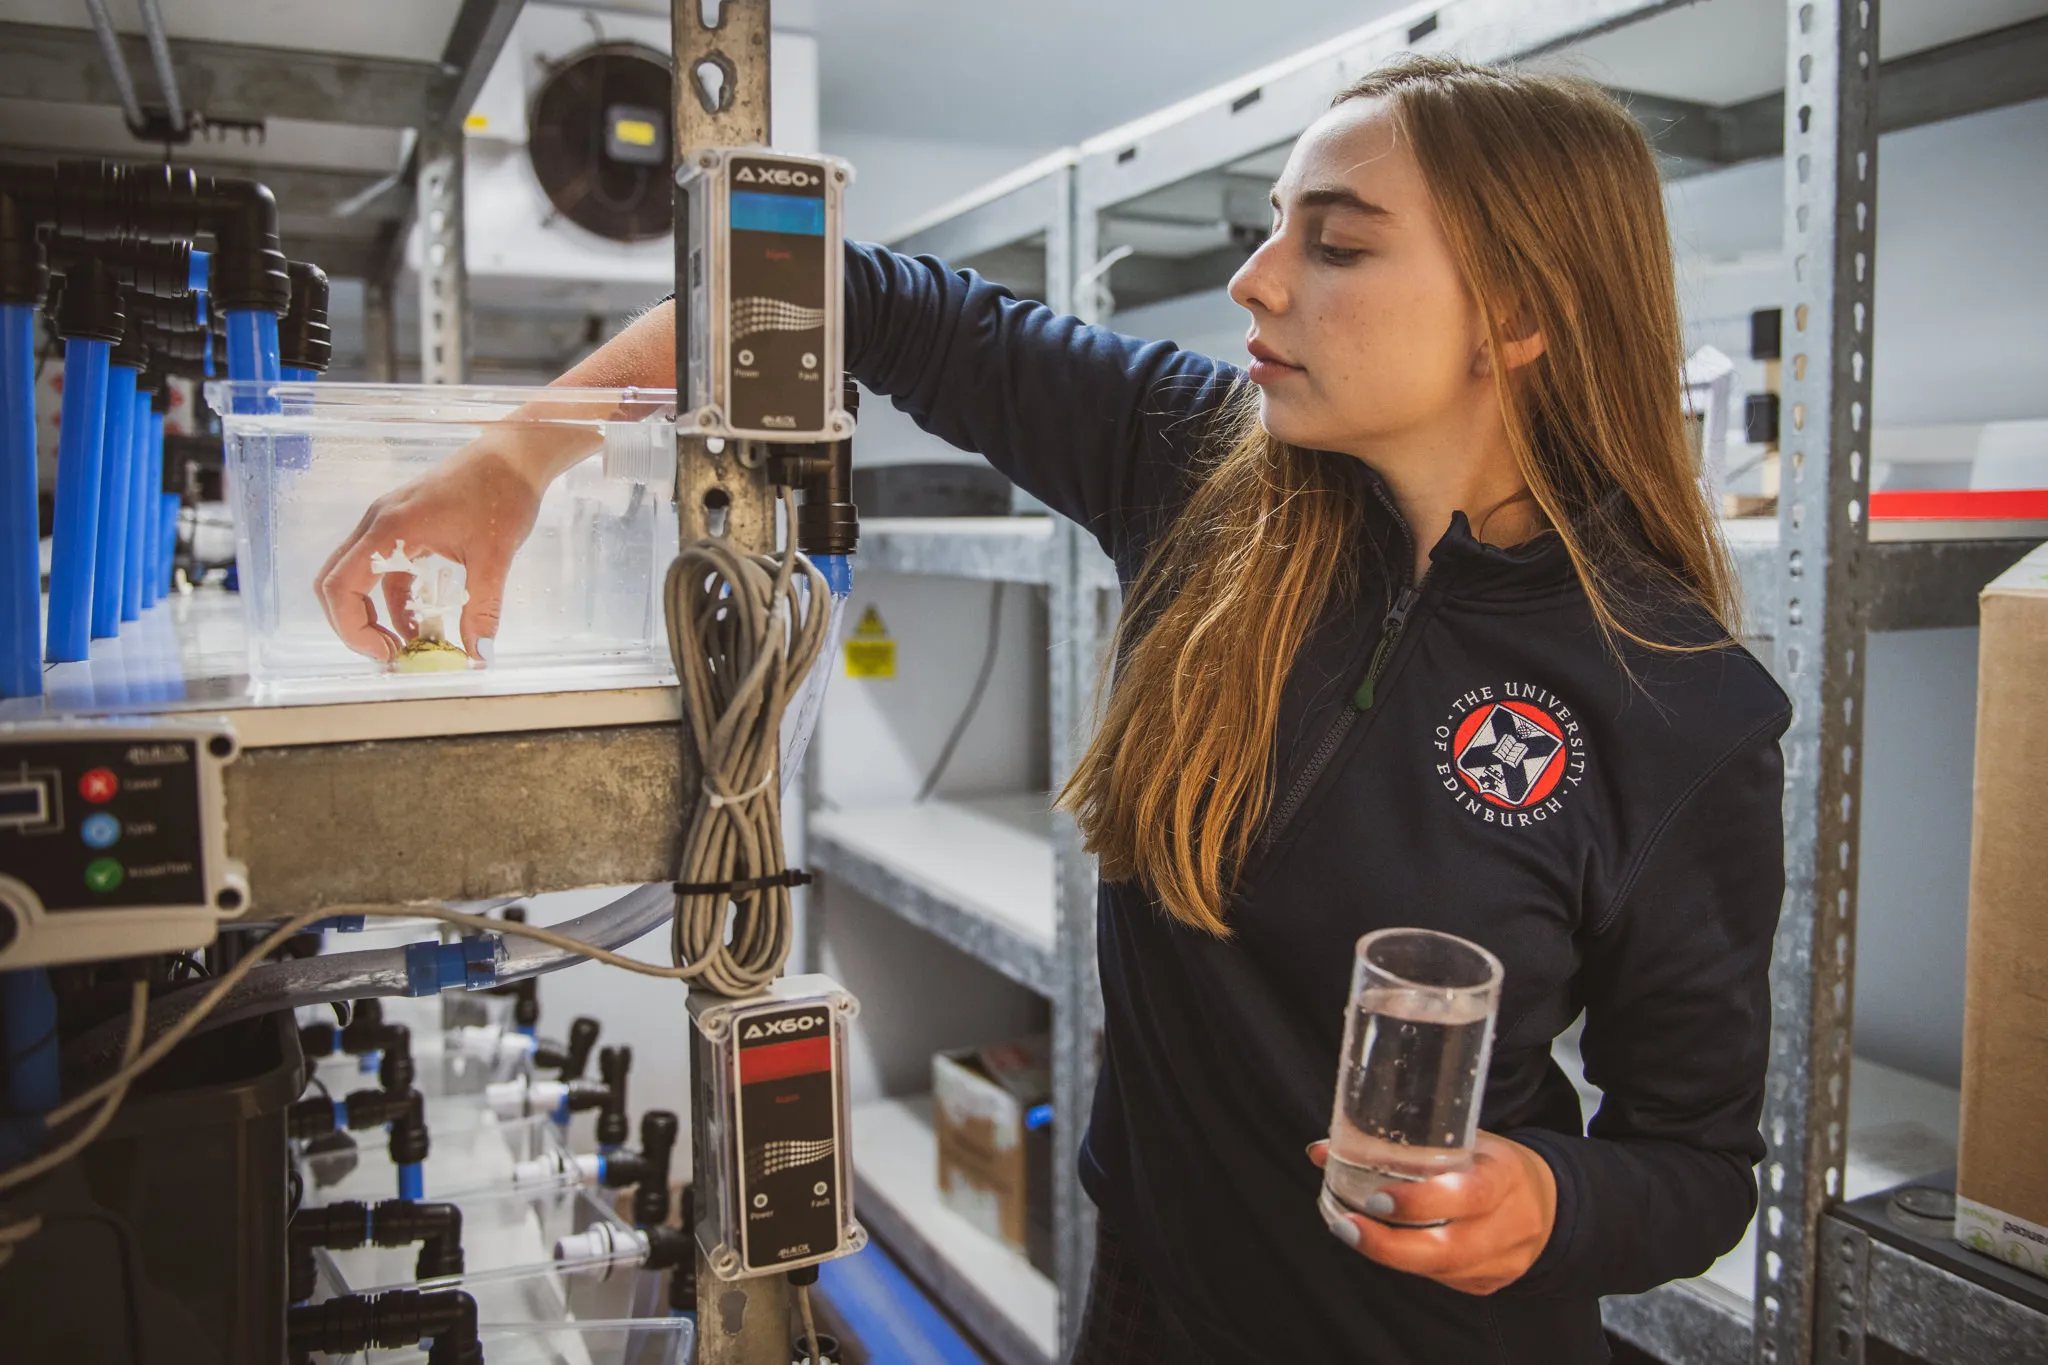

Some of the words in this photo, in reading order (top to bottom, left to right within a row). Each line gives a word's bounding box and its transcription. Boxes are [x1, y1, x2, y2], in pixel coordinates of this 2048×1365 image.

[1434, 725, 1450, 751] OF
[1452, 686, 1494, 713] THE
[1504, 682, 1585, 787] UNIVERSITY
[1436, 762, 1563, 827] EDINBURGH
[743, 1016, 825, 1040] AX60+
